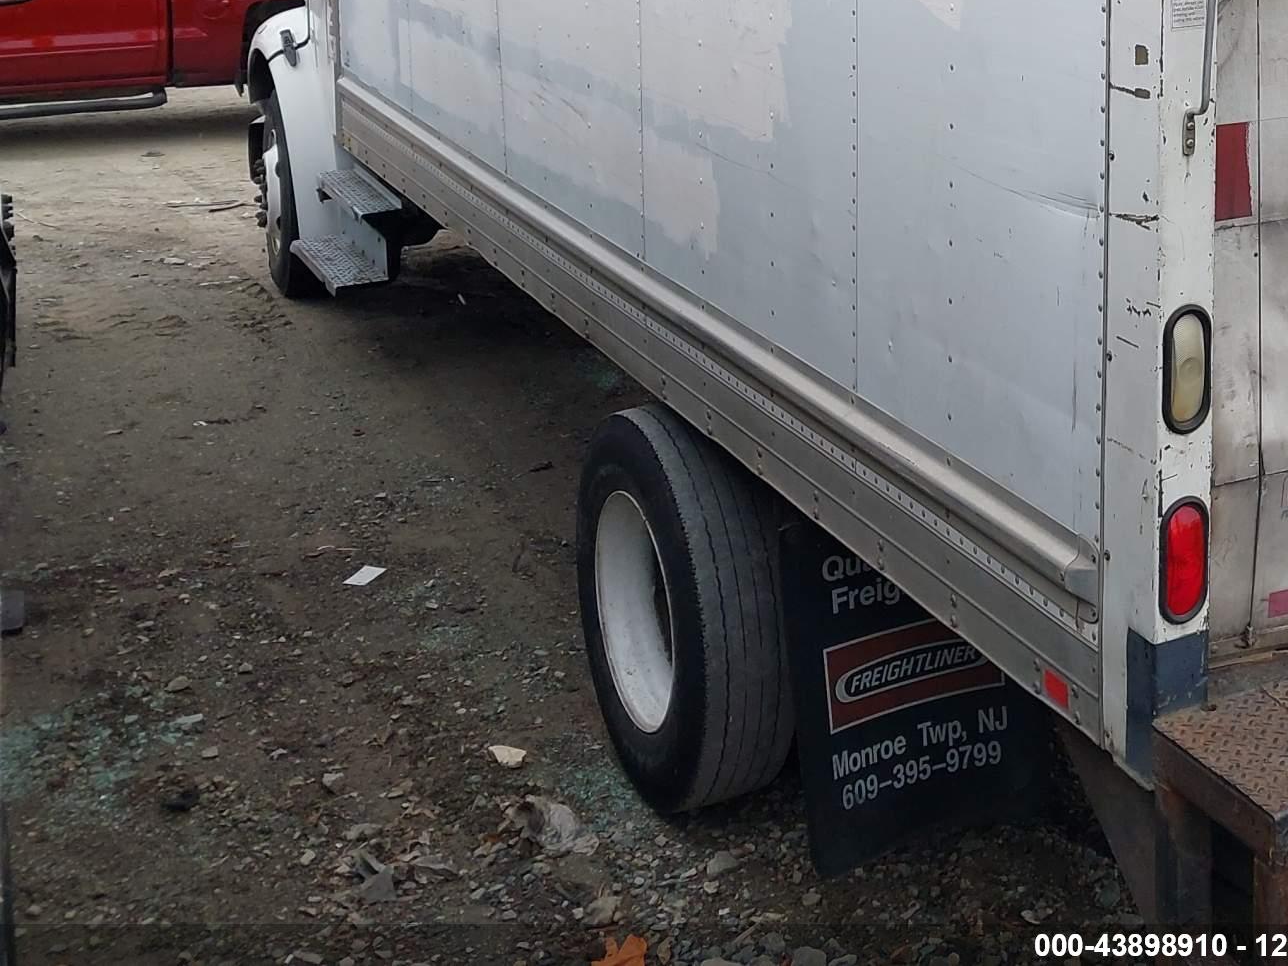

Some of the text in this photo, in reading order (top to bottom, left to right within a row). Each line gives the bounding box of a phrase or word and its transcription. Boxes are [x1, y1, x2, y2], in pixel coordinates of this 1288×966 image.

[850, 645, 977, 694] FREIGHTLINER
[832, 705, 1008, 780] Monroe Twp, NJ
[841, 740, 1002, 810] 609-395-9799
